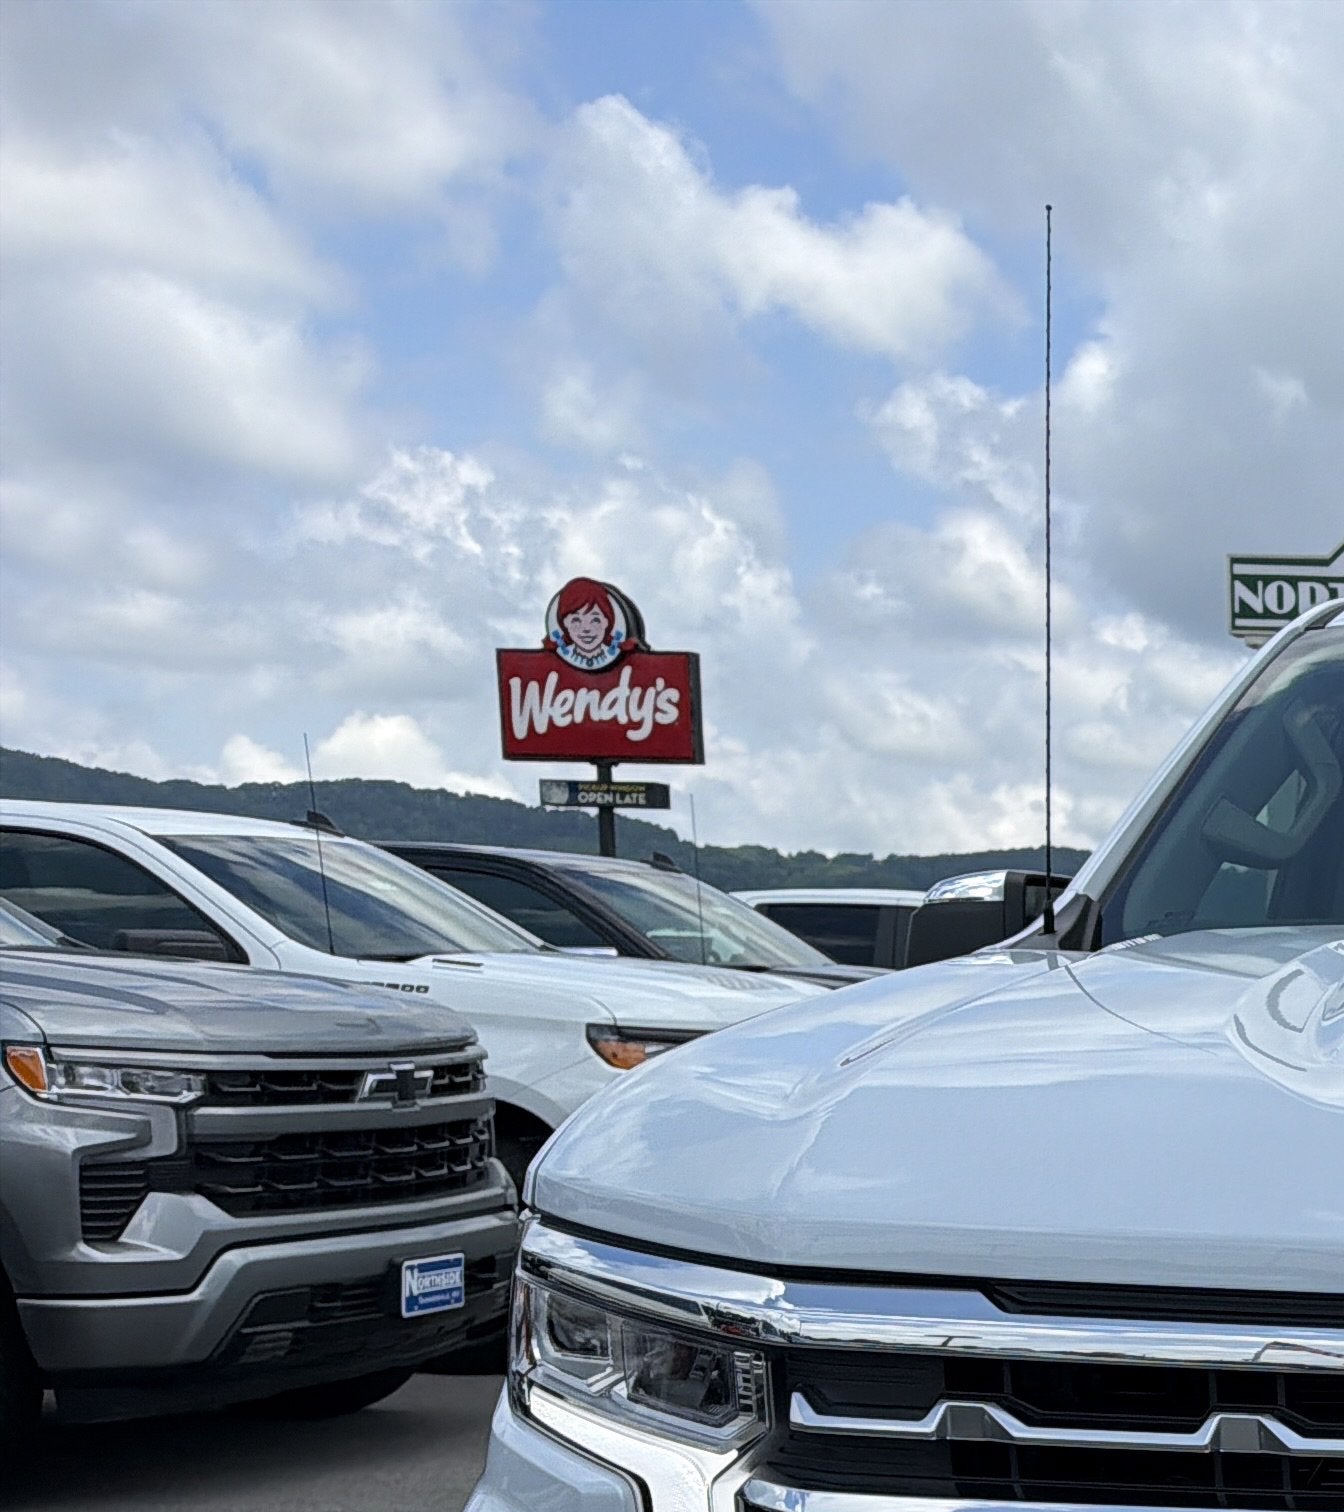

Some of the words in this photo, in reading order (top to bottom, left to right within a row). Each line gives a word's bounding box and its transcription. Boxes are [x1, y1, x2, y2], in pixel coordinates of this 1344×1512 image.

[508, 665, 681, 742] Wendy's
[578, 791, 613, 804] OPEN
[616, 793, 647, 805] LATE
